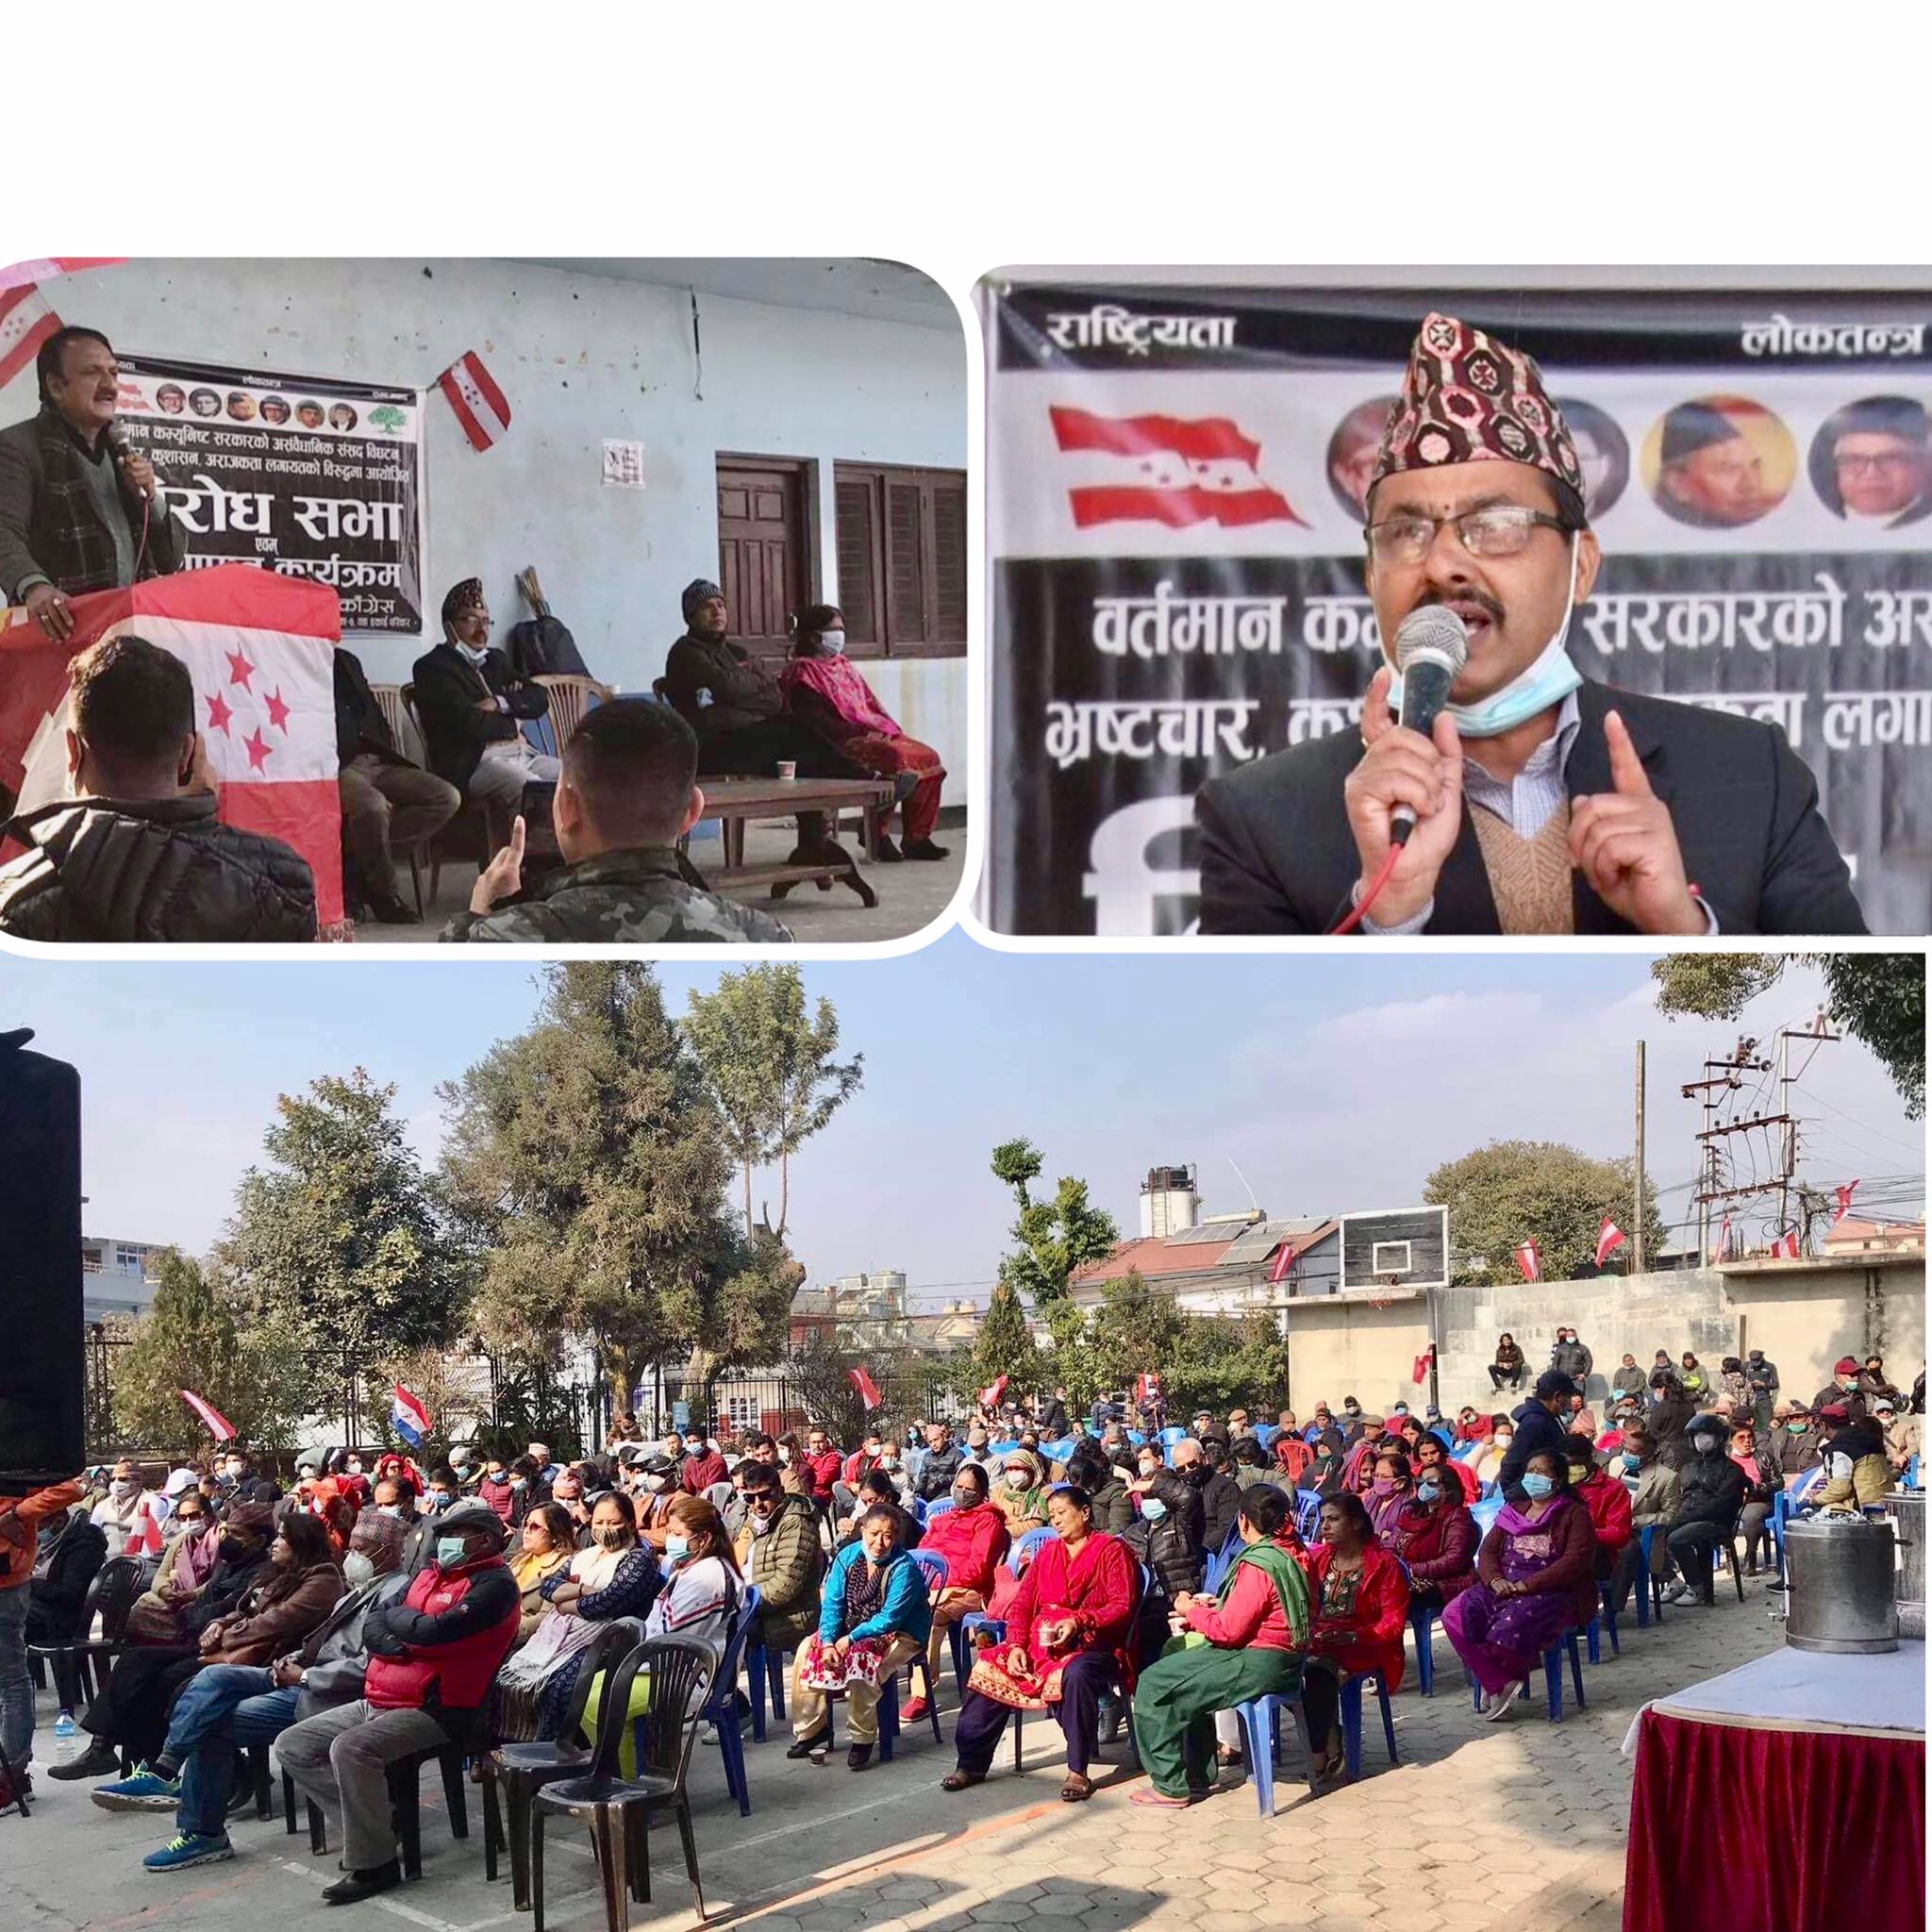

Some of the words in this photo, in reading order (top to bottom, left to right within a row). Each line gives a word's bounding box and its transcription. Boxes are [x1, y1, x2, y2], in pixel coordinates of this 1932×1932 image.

[1046, 305, 1237, 356] राष्ट्रियता
[1740, 313, 1927, 356] लोकतन्त्र
[205, 453, 262, 472] अराजकता
[213, 431, 270, 450] सरकारको
[336, 441, 364, 460] संसद
[154, 473, 276, 535] रोध
[292, 495, 405, 541] सभा
[1092, 579, 1289, 658] वर्तमान
[1582, 572, 1846, 654] सरकारको
